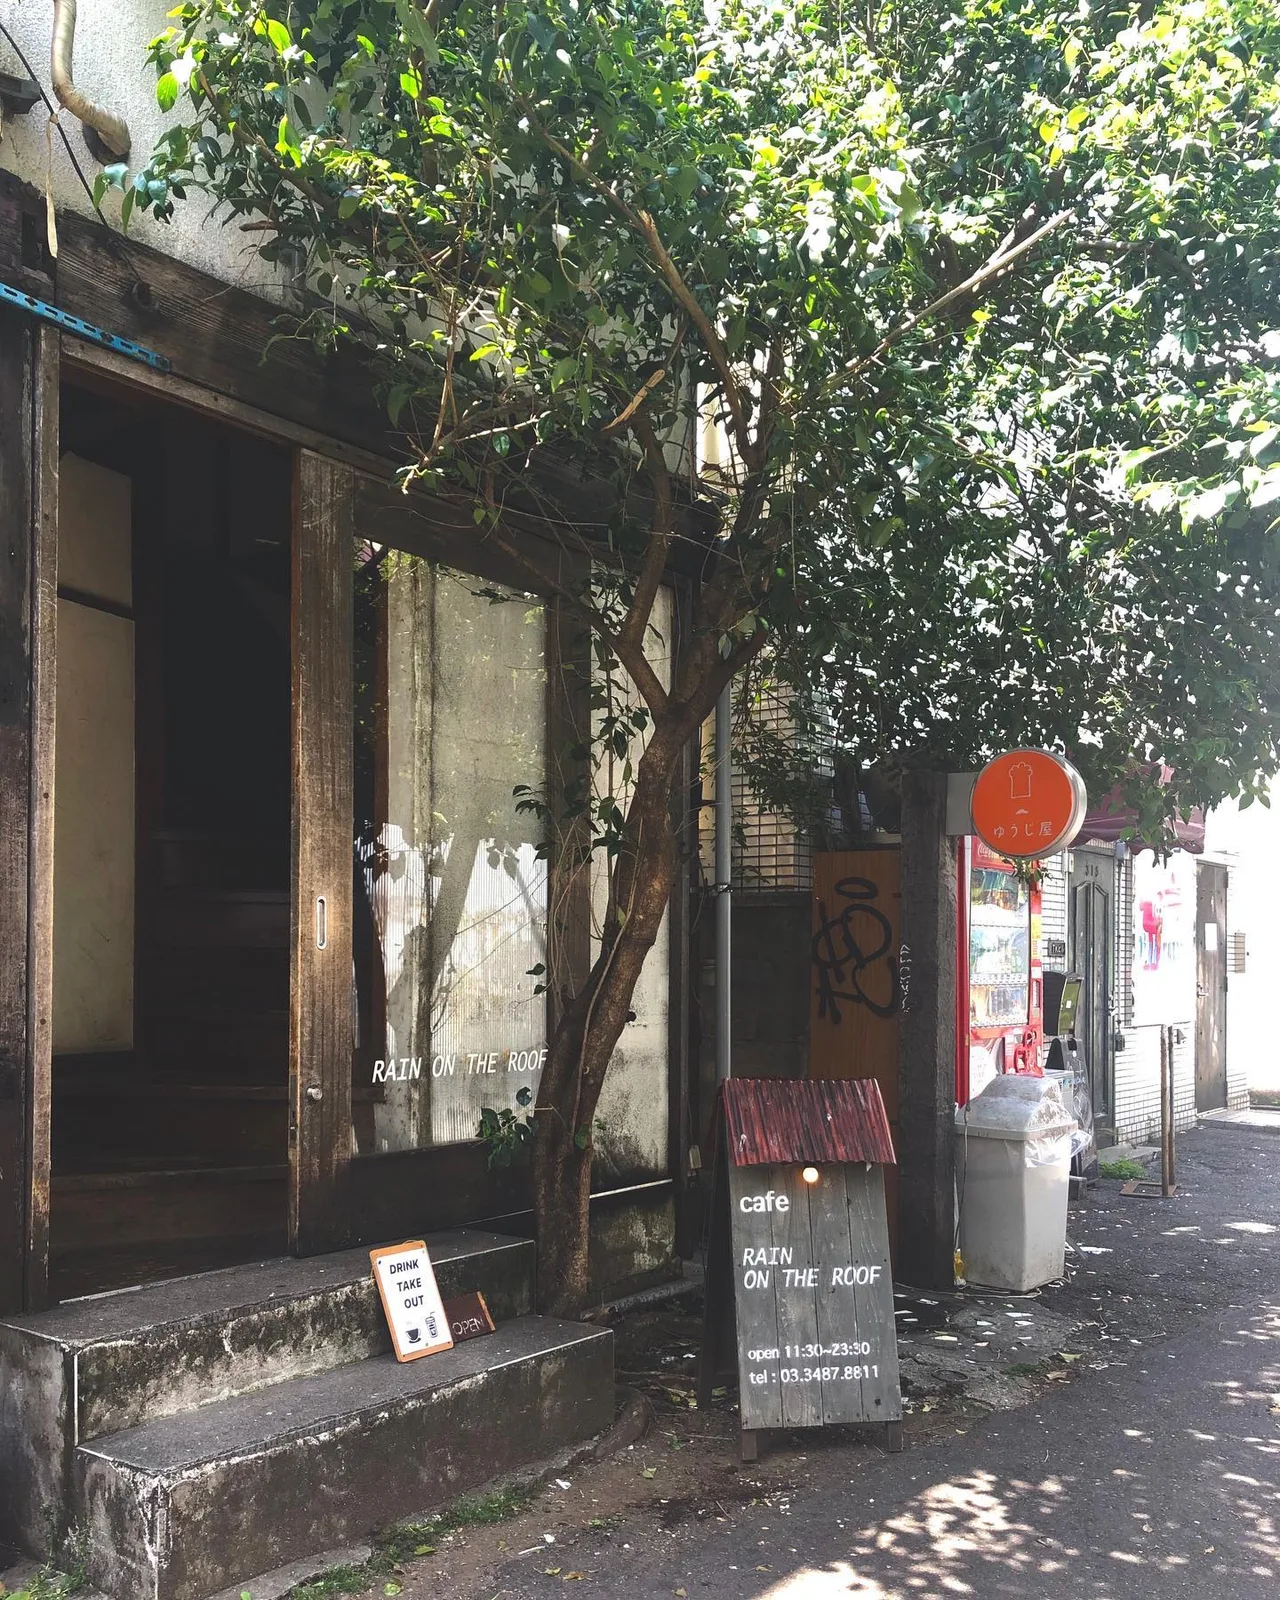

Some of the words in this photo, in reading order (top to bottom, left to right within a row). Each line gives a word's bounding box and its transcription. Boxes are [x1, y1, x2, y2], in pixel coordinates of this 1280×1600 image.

[993, 821, 1052, 838] ゆうじ屋
[372, 1057, 422, 1083] RAIN
[432, 1054, 456, 1078] ON
[467, 1052, 498, 1074] THE
[507, 1049, 549, 1072] ROOF
[740, 1191, 789, 1212] cafe
[743, 1247, 793, 1266] RAIN
[390, 1259, 419, 1274] DRINK
[396, 1277, 422, 1292] TAKE
[744, 1270, 769, 1289] ON
[782, 1268, 819, 1287] THE
[832, 1266, 882, 1286] ROOF
[404, 1295, 424, 1309] OUT
[452, 1316, 485, 1335] OPEN
[748, 1348, 779, 1362] open
[785, 1342, 870, 1358] 11:30~23:30
[780, 1365, 879, 1382] 03.3487.8811
